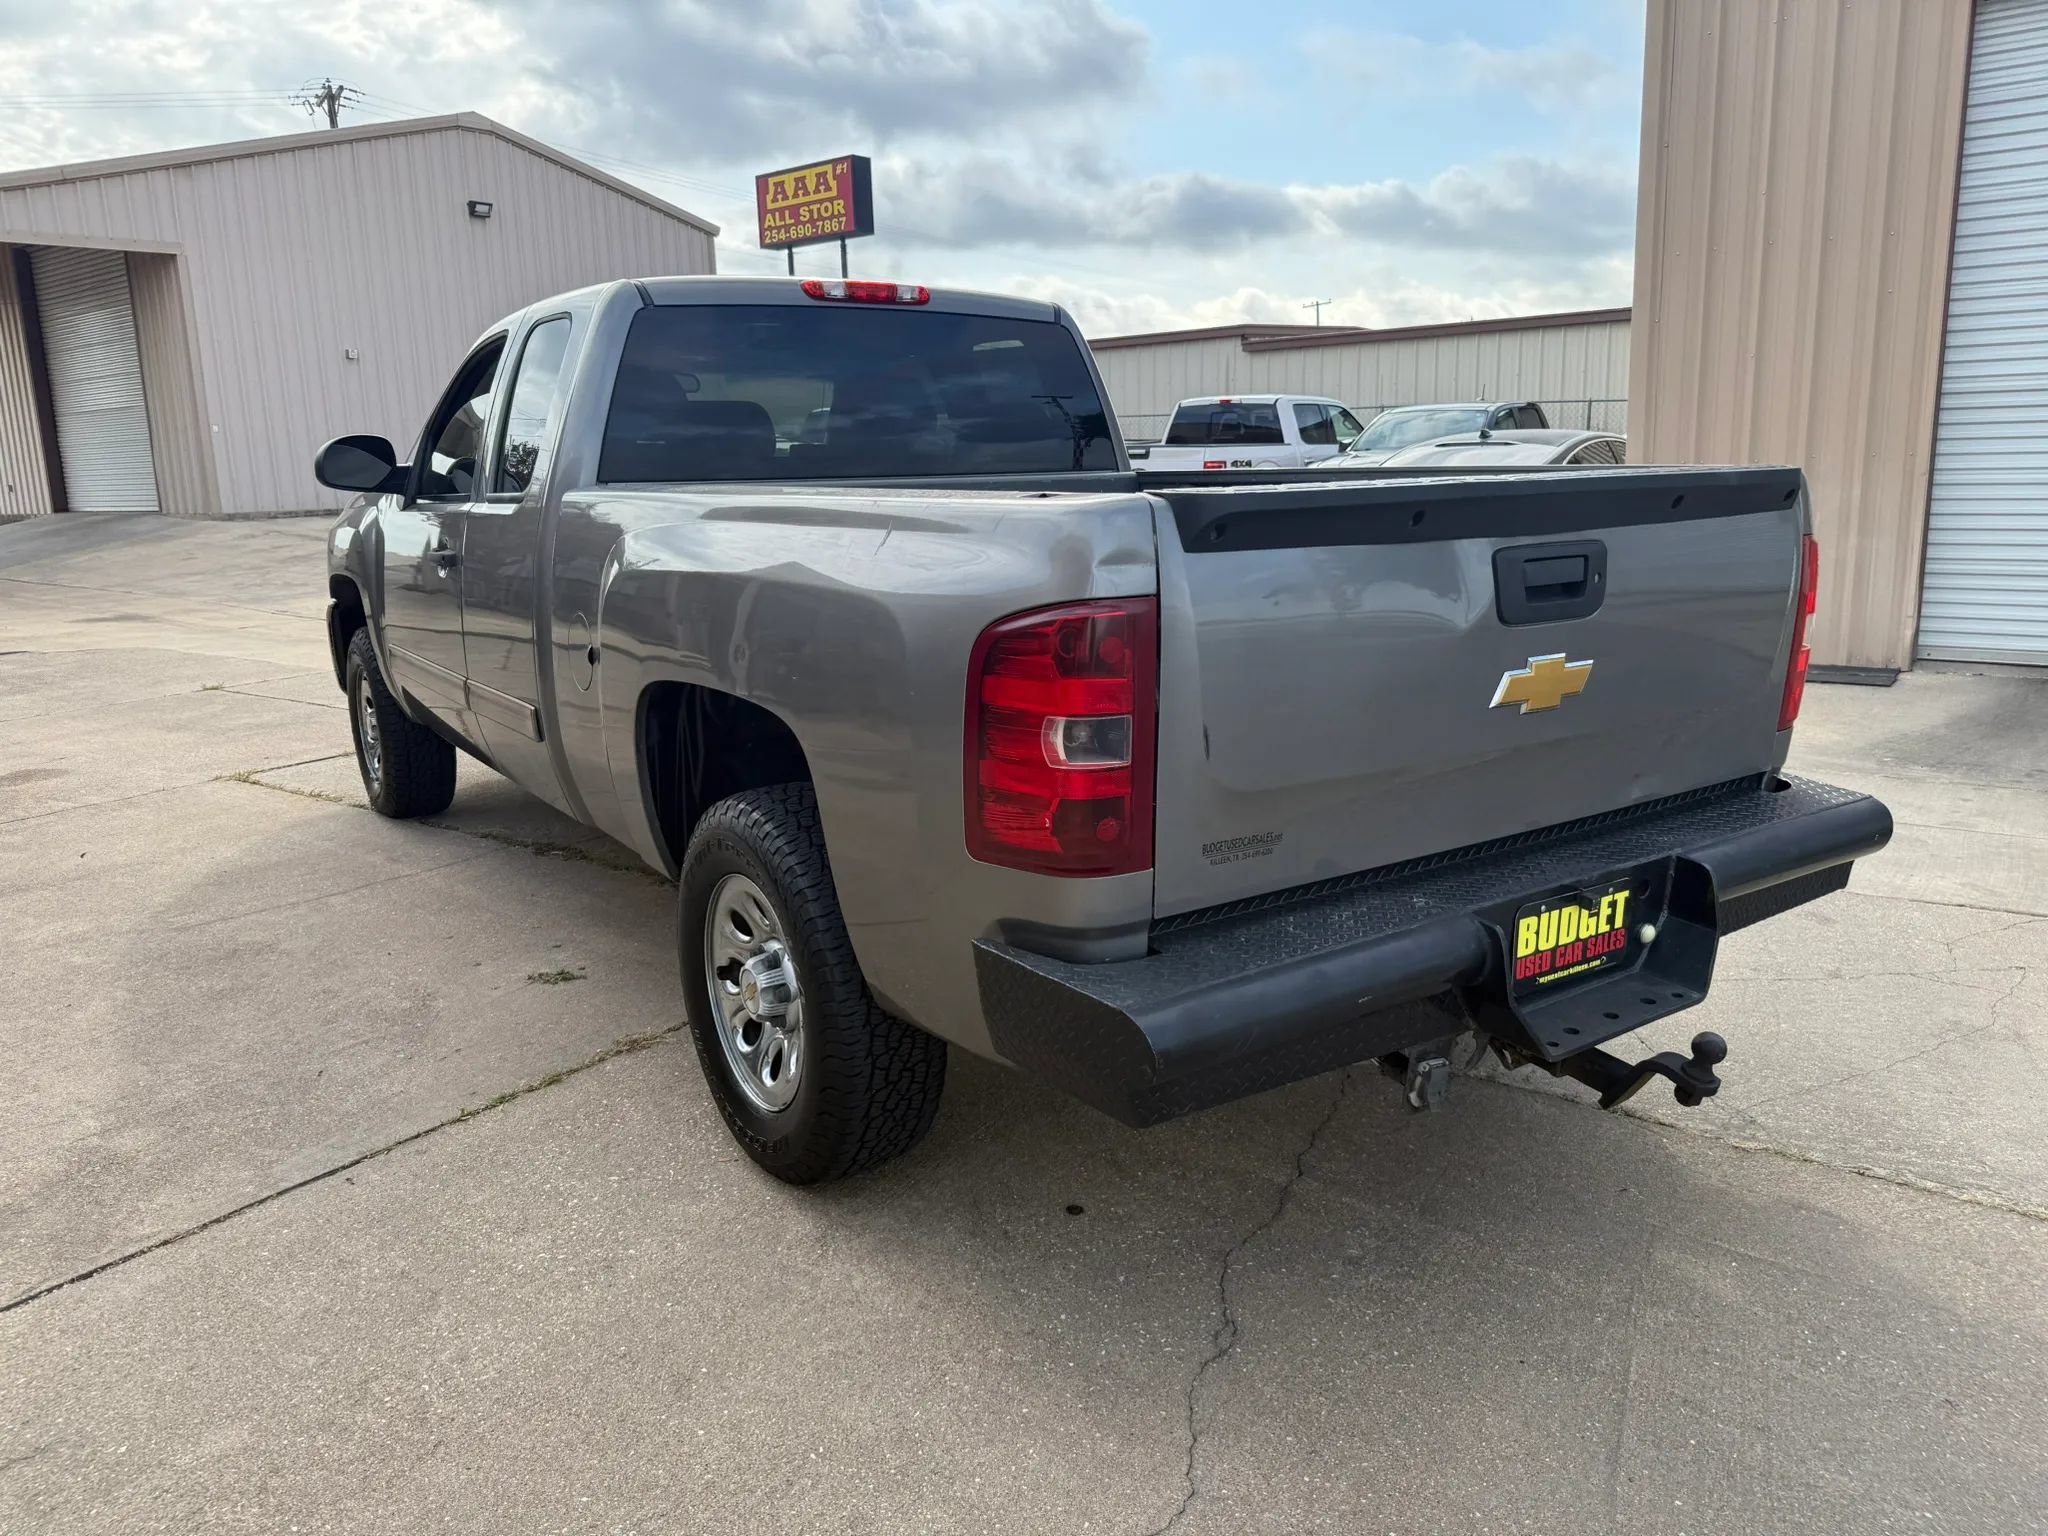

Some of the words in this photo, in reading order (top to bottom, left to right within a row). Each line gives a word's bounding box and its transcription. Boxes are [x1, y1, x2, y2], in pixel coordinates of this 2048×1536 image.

[771, 170, 833, 204] AAA
[835, 162, 848, 175] #1
[764, 210, 794, 229] ALL
[800, 199, 845, 221] STOR
[764, 217, 847, 244] 254-690-7867
[1515, 951, 1552, 981] USED
[1555, 941, 1583, 968] CAR
[1586, 928, 1626, 958] SALES
